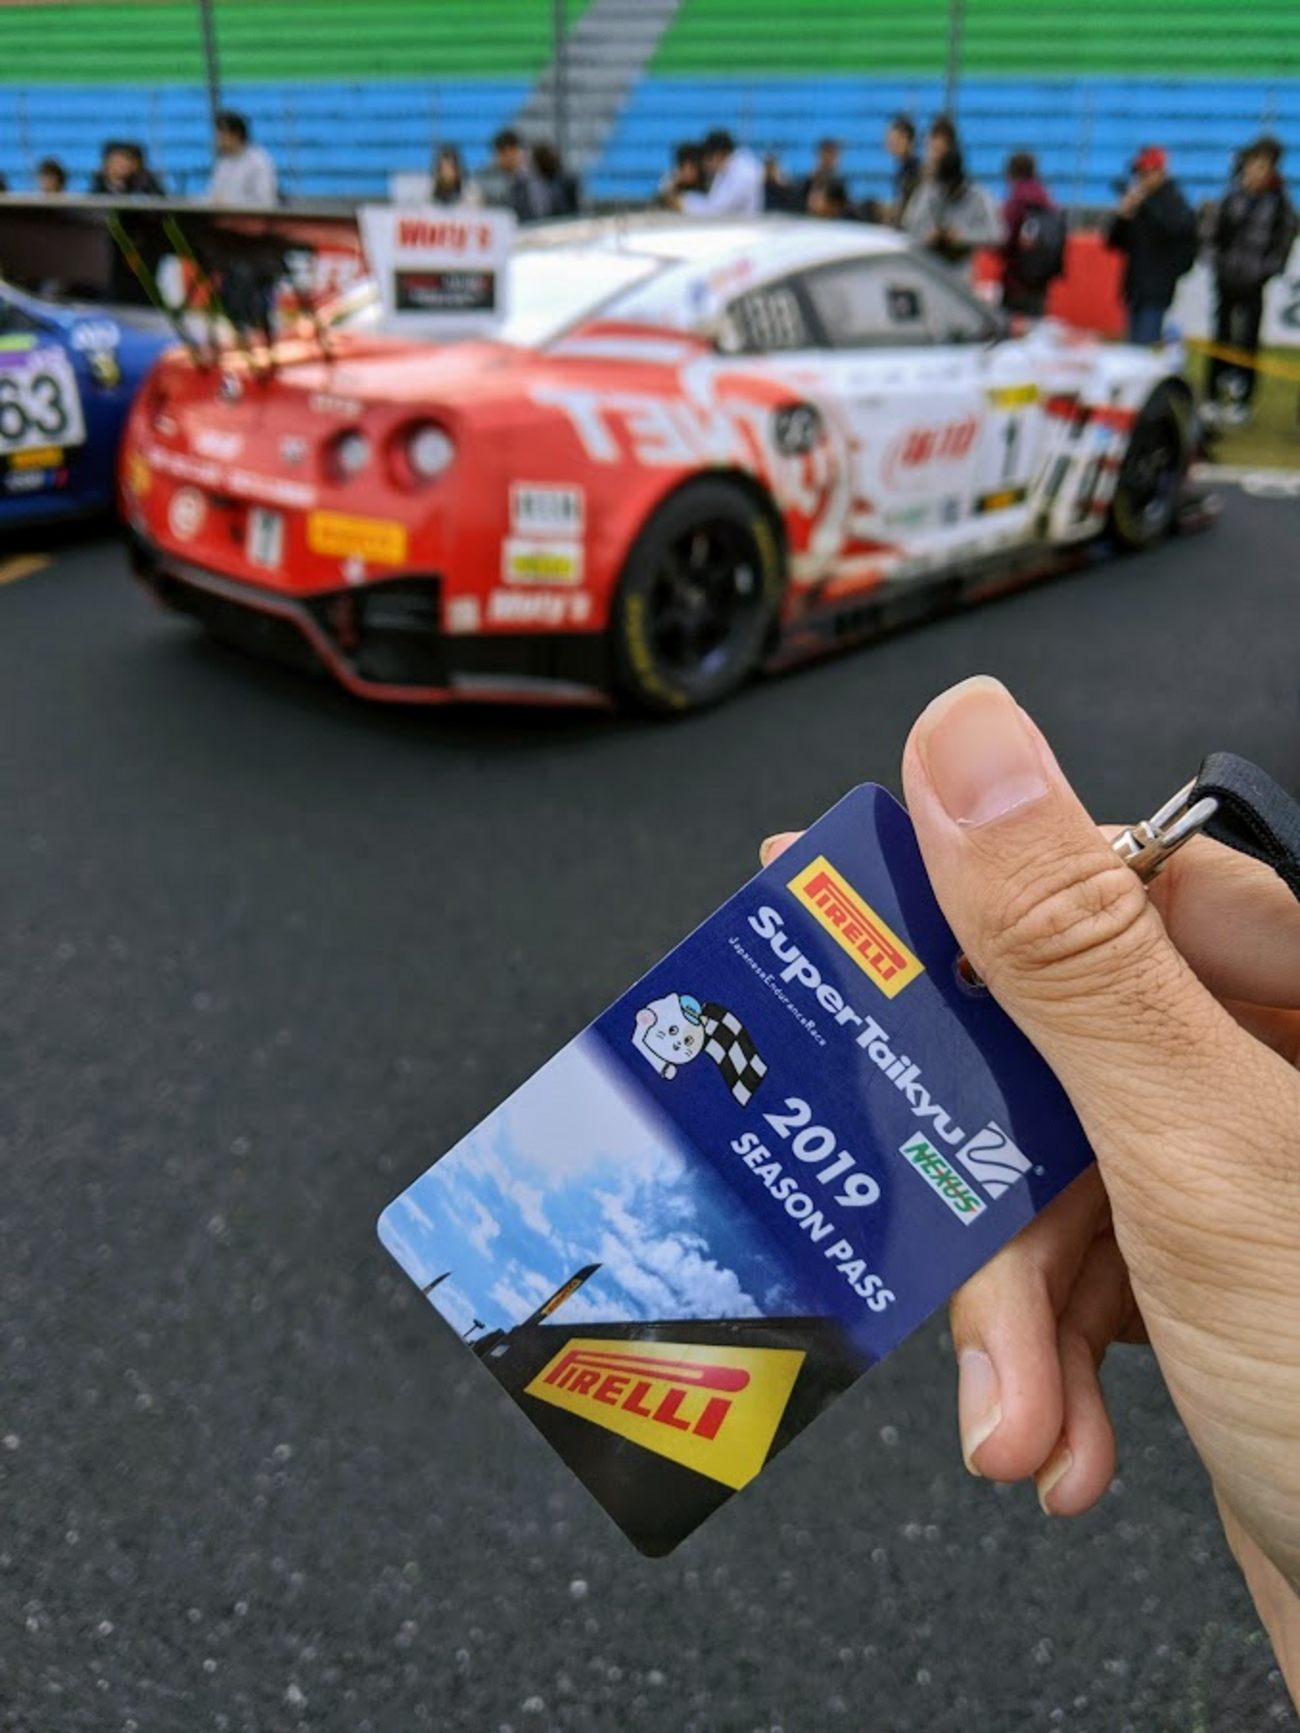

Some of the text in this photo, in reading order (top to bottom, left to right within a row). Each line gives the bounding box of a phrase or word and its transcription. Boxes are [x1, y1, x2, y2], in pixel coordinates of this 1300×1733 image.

[803, 872, 907, 981] PIRELLI
[762, 1097, 880, 1207] 2019
[903, 1142, 981, 1213] NEXUS
[730, 1132, 896, 1313] SEASON PASS
[543, 1349, 751, 1441] PIRELLI
